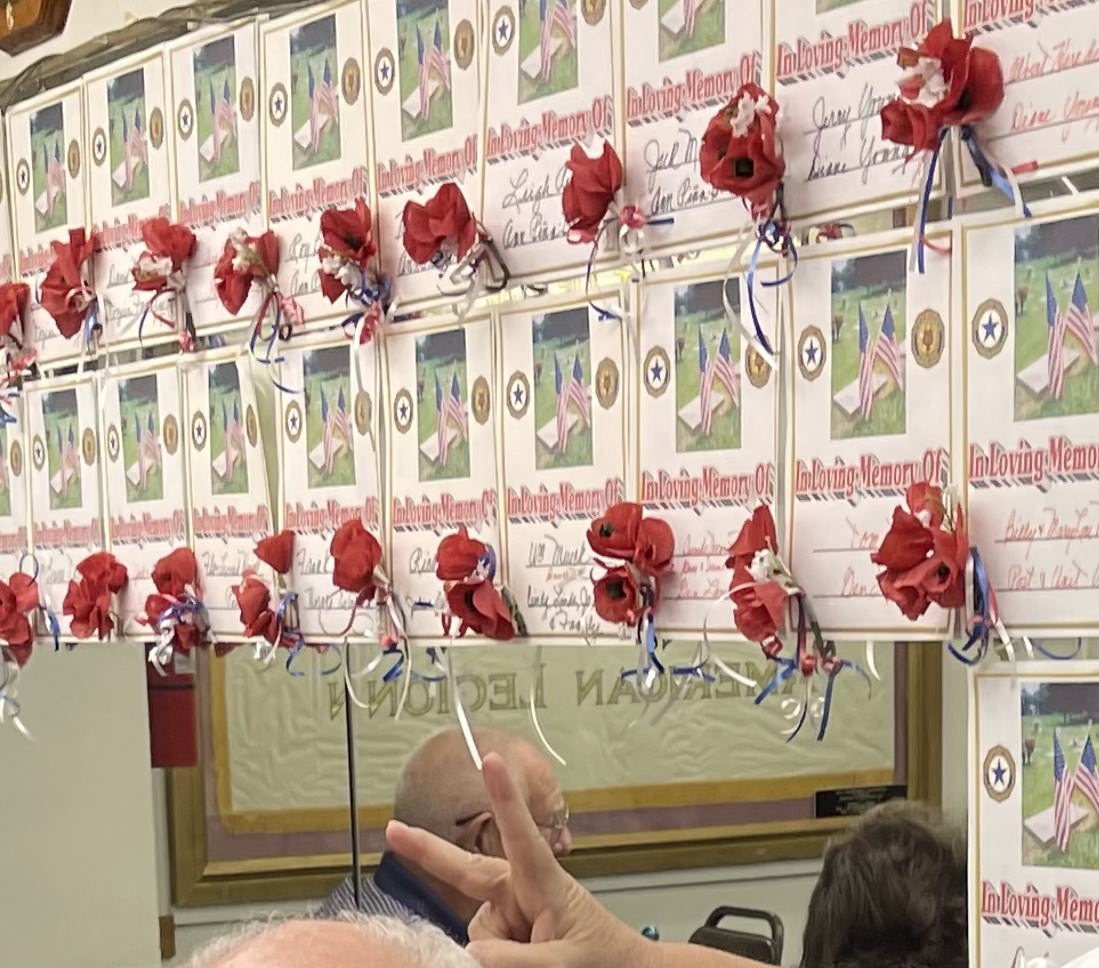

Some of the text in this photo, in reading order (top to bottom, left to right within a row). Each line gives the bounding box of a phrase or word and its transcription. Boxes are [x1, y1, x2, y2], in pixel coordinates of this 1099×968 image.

[776, 1, 927, 76] In Loving Memory Of
[628, 89, 642, 117] In
[642, 78, 683, 115] Loving
[686, 69, 736, 101] Memory
[501, 118, 538, 152] Loving
[542, 111, 587, 139] Memory
[796, 450, 942, 496] In Loving Memory Of
[969, 444, 985, 478] In
[989, 440, 1043, 482] Loving
[521, 484, 556, 518] Loving
[560, 482, 600, 512] Memory
[642, 462, 770, 506] In Loving Memory Of
[982, 881, 996, 913] In
[1001, 882, 1050, 927] Loving
